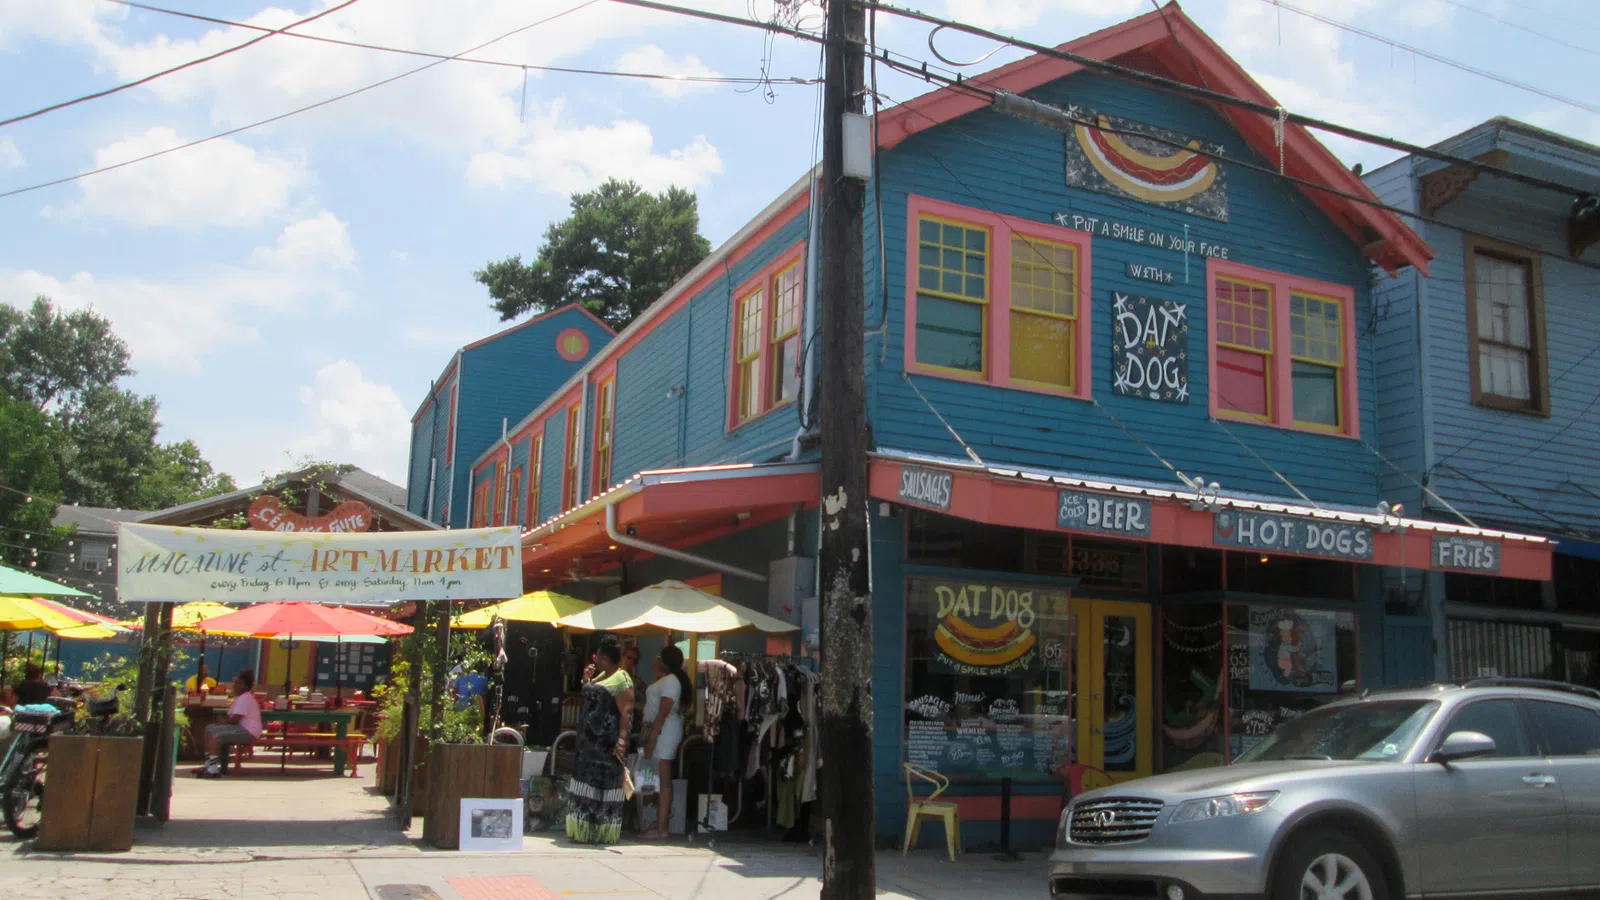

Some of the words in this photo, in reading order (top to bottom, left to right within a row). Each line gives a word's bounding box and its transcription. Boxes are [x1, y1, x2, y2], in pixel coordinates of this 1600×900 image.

[1073, 215, 1098, 233] PUT
[1101, 222, 1110, 235] A
[1112, 223, 1145, 242] SMiLE
[1149, 232, 1164, 248] ON
[1169, 235, 1196, 253] YOUR
[1200, 243, 1229, 259] FACE
[1130, 263, 1163, 282] WiTH
[1116, 304, 1179, 349] DAT
[1123, 352, 1180, 390] DOG
[899, 470, 951, 508] SAUSAGES
[1060, 505, 1085, 520] COLD
[1086, 498, 1146, 531] BEER
[1237, 518, 1294, 547] HOT
[1306, 524, 1368, 555] DOGS
[126, 550, 253, 575] MAGAZINE
[299, 548, 368, 574] ART
[371, 545, 516, 574] MARKET
[1438, 542, 1494, 569] FRIES
[211, 580, 237, 592] every
[240, 577, 270, 592] Friday
[335, 579, 359, 591] every
[363, 577, 409, 592] Saturday
[935, 585, 987, 618] DAT
[1045, 642, 1062, 658] 65
[1230, 652, 1248, 667] 65
[960, 665, 988, 676] SMILE
[909, 694, 951, 713] SAUSAGES
